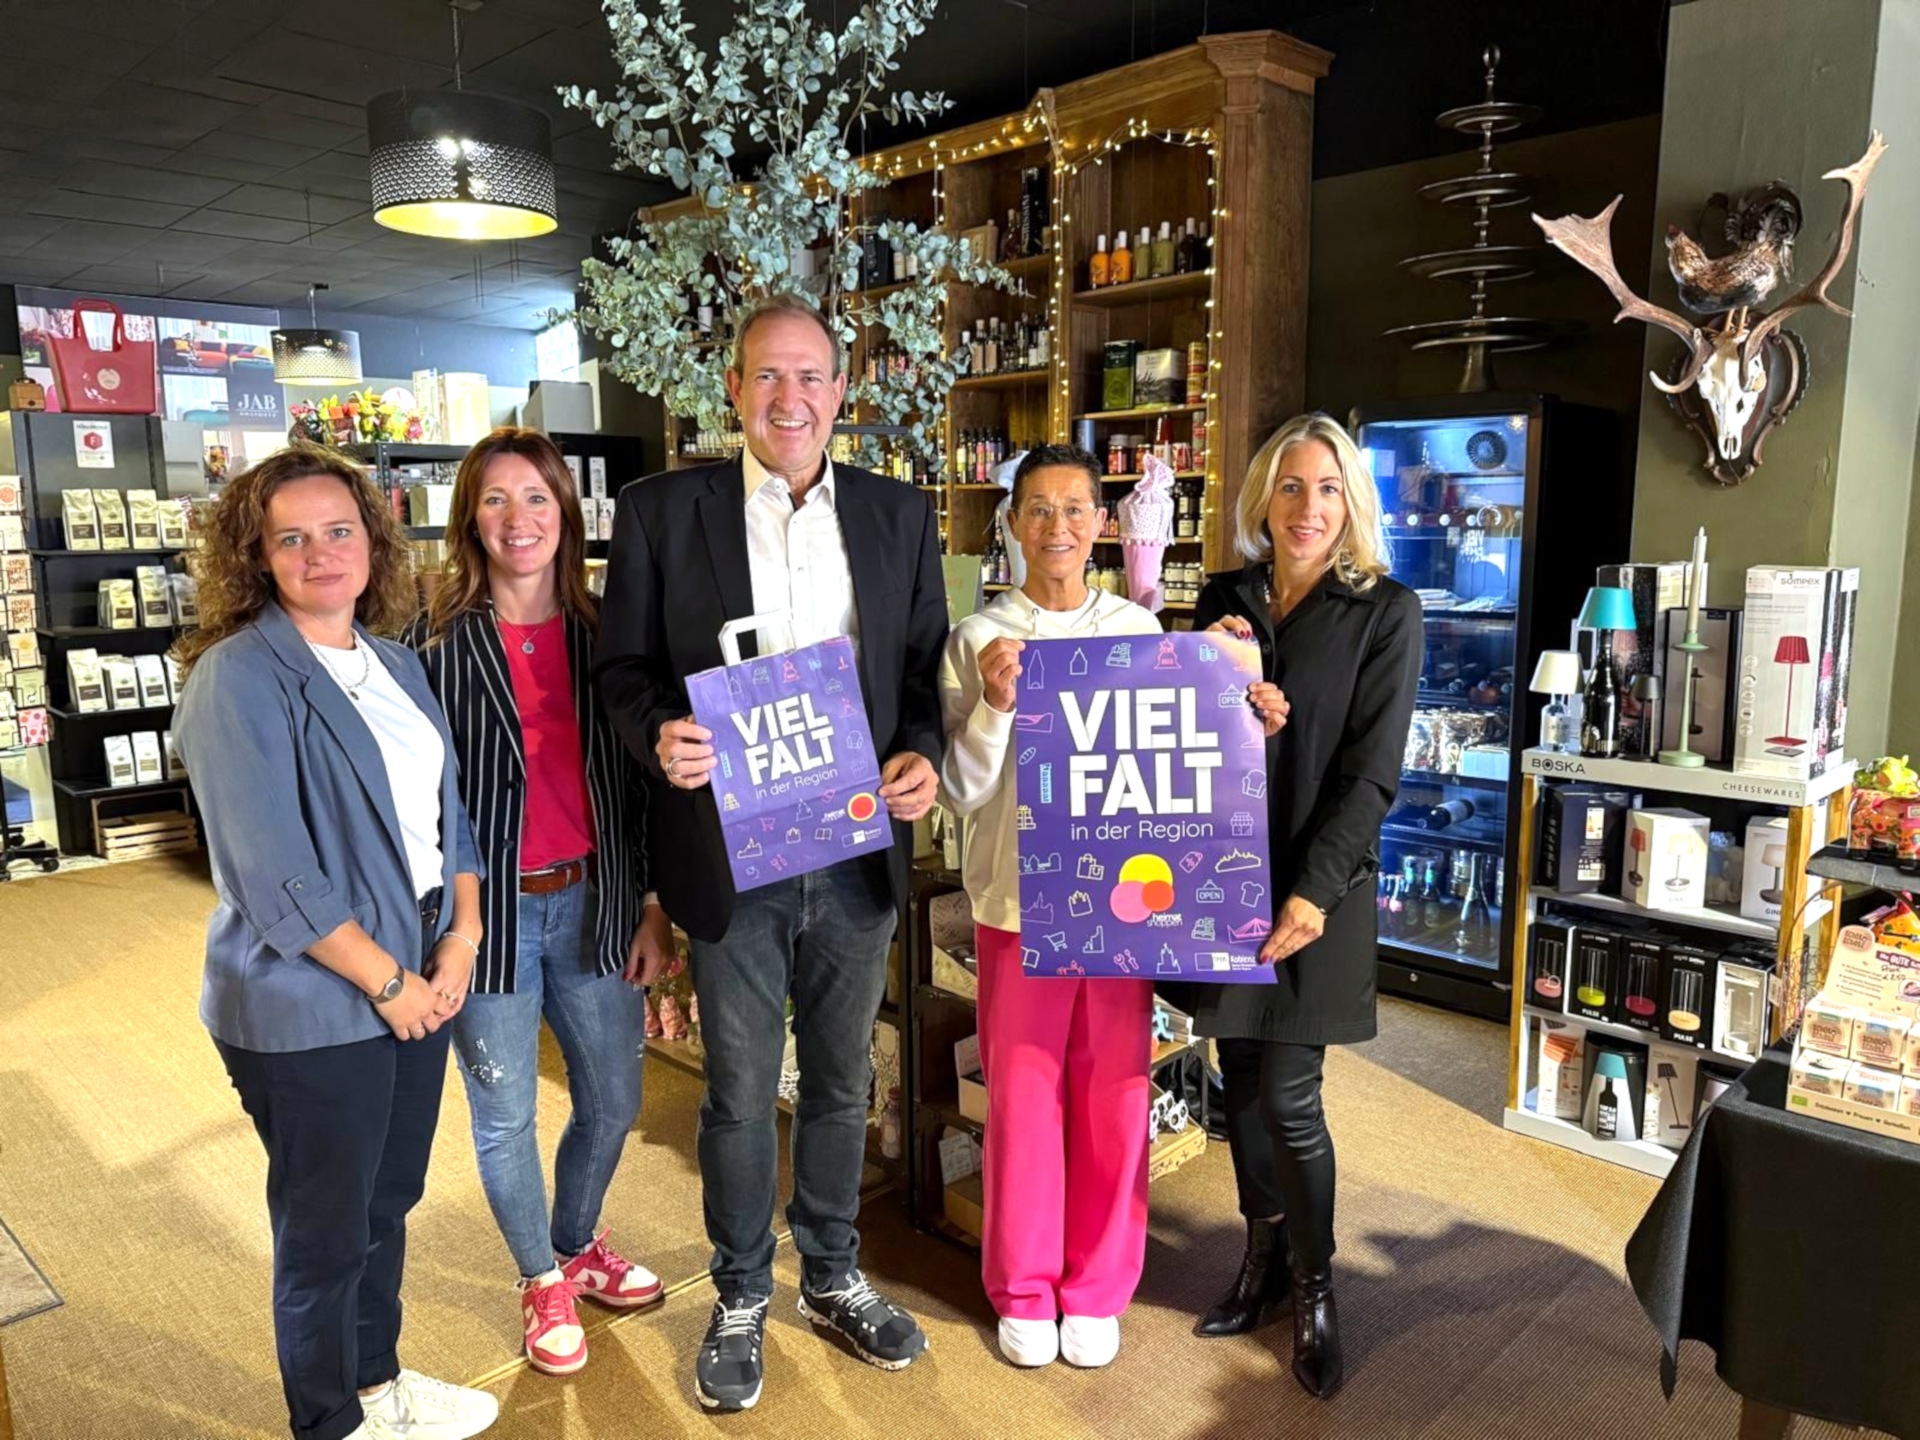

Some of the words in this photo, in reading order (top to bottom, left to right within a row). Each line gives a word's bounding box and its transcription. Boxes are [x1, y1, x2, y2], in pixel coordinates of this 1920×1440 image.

[238, 393, 276, 410] JAB
[730, 692, 830, 747] VIEL
[1058, 687, 1219, 752] VIEL
[744, 725, 835, 786] FALT
[1531, 758, 1586, 775] BOSKA
[756, 788, 767, 800] in
[770, 782, 791, 795] der
[794, 768, 838, 788] Region
[1069, 751, 1223, 817] FALT
[1722, 782, 1801, 799] CHEESEWARES
[1071, 823, 1089, 841] in
[1095, 821, 1132, 840] der
[1139, 820, 1214, 842] Region
[1199, 891, 1221, 900] OPEN
[1765, 908, 1781, 916] GIN
[1582, 1008, 1600, 1018] PULSE
[1630, 1017, 1649, 1027] PULSE
[1673, 1032, 1694, 1043] PULSE
